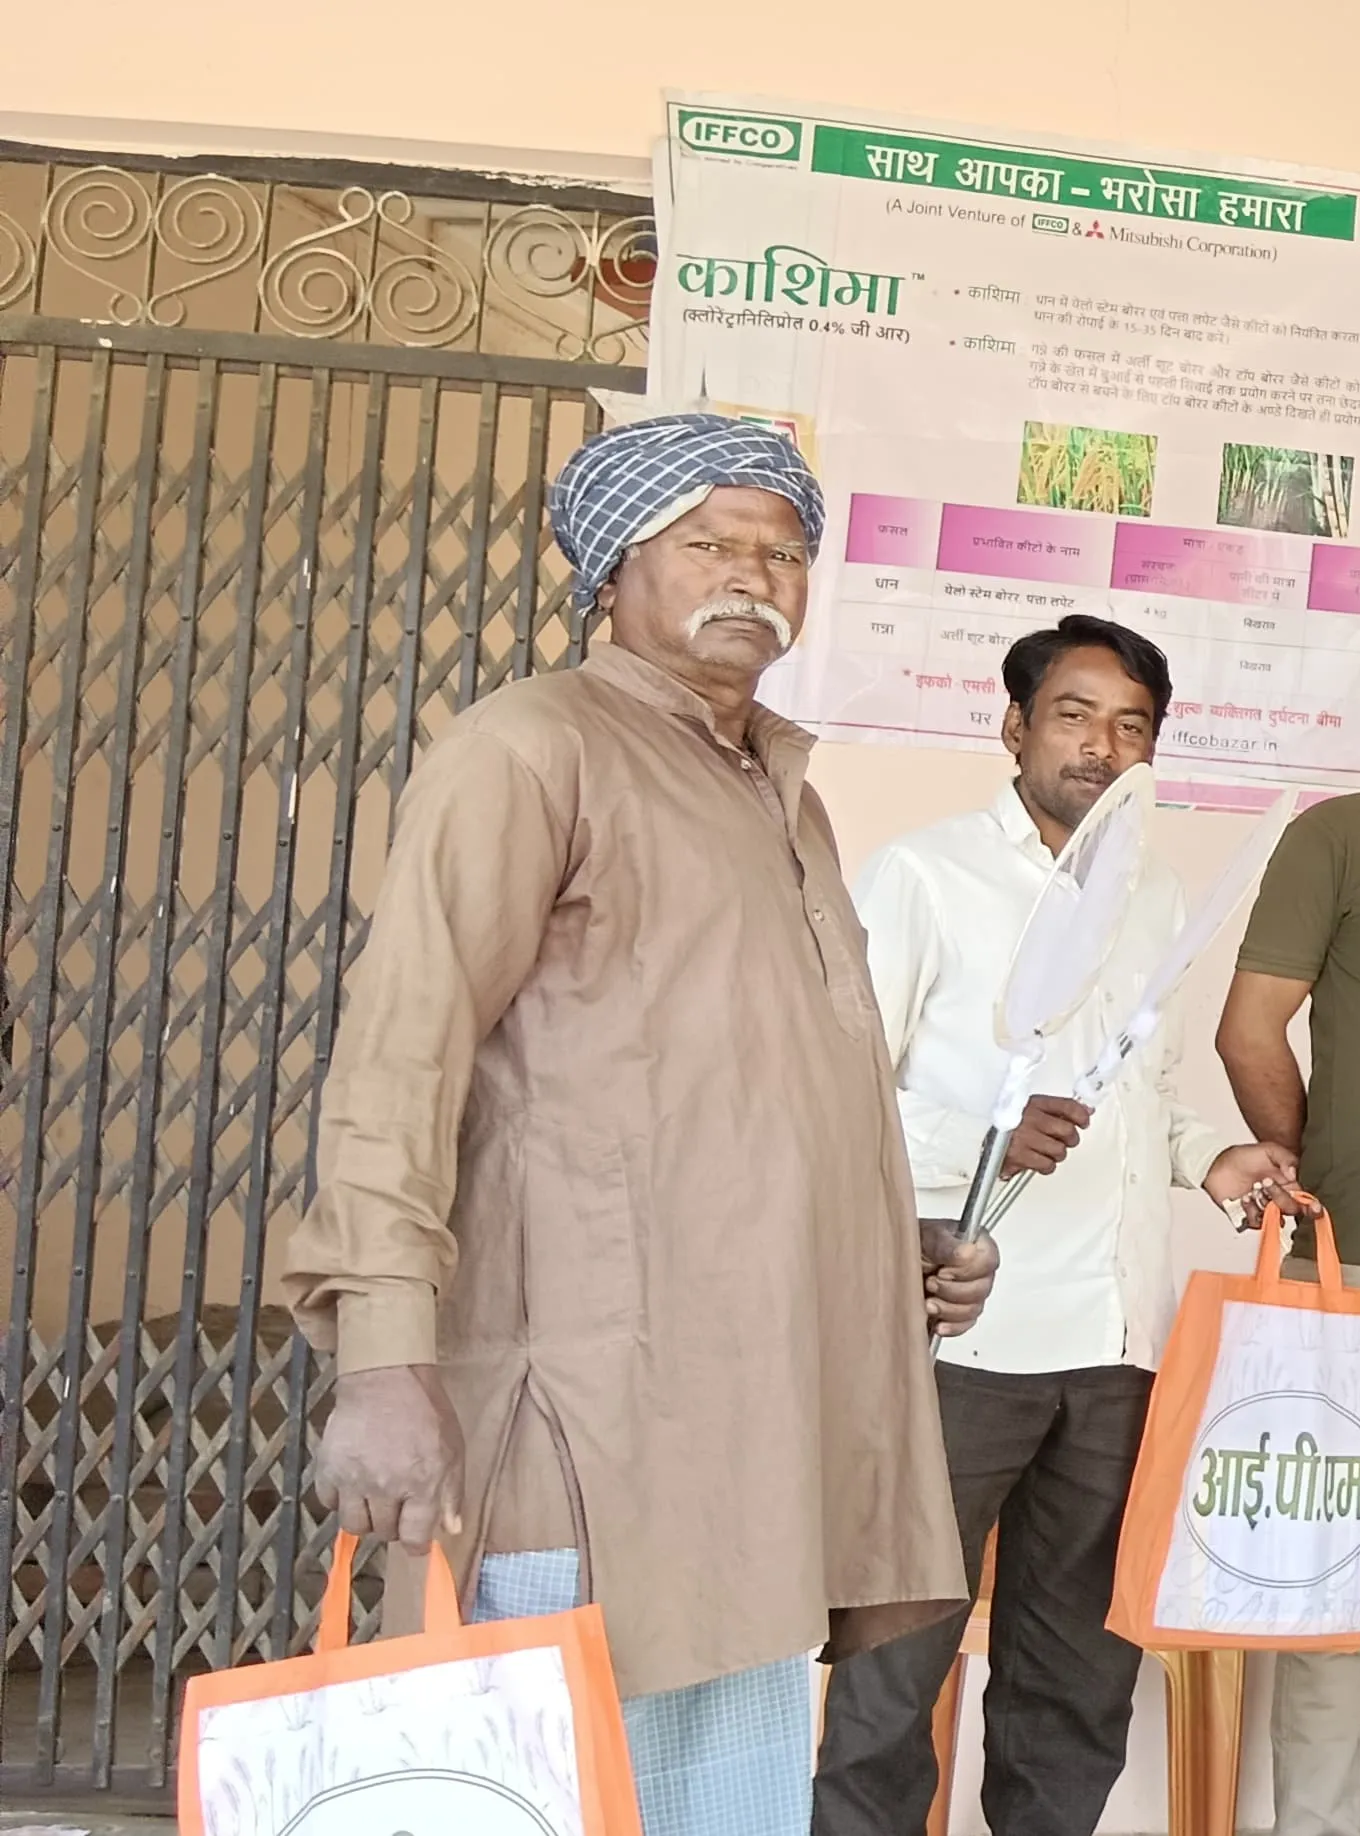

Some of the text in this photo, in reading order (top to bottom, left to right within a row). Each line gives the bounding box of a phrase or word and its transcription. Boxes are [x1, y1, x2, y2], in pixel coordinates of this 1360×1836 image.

[694, 121, 781, 149] IFFCO
[865, 144, 940, 184] साथ
[954, 158, 1065, 201] आपका
[1100, 168, 1203, 220] भरोसा
[1217, 191, 1308, 232] हमारा
[886, 198, 1278, 263] (A Joint Venture of IFFCO & Mitsubishi Corporation)
[676, 244, 906, 316] काशिमा
[968, 284, 1021, 304] काशिमा
[809, 320, 845, 336] 0.4%
[851, 318, 870, 339] जी
[875, 324, 911, 345] आर)
[963, 334, 1016, 355] काशिमा
[875, 577, 900, 590] धान
[970, 711, 992, 726] घर
